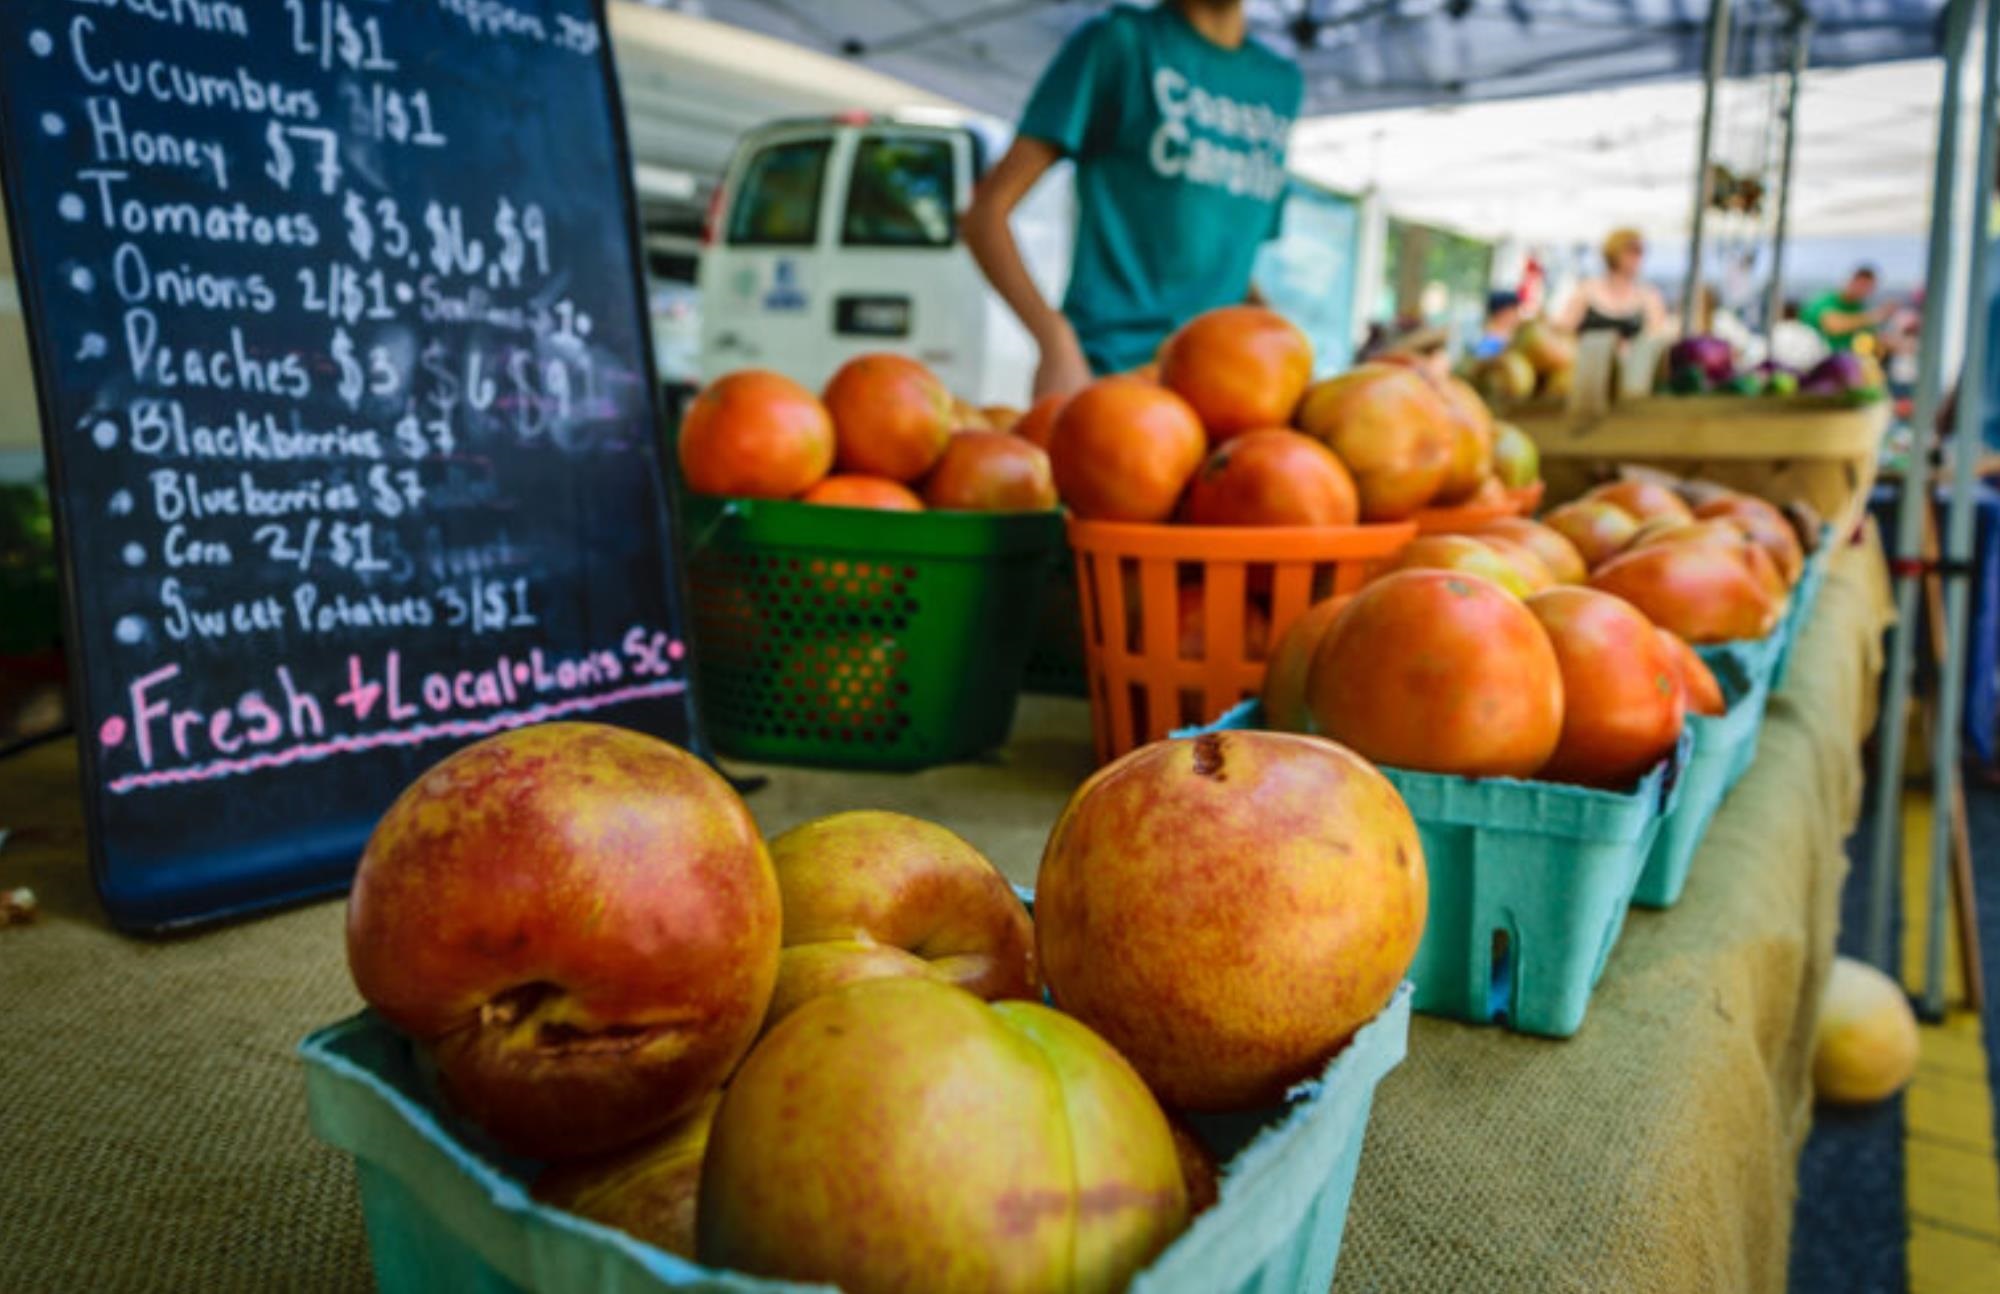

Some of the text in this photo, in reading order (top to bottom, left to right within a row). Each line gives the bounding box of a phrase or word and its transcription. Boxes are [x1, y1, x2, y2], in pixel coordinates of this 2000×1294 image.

[69, 15, 321, 120] Cucumbers
[86, 98, 343, 195] Honey $7
[76, 168, 320, 247] Tomatoes
[113, 242, 276, 313] Onions
[123, 307, 311, 399] Peaches
[330, 325, 400, 412] $3
[129, 398, 454, 460] Blackberries $7
[148, 464, 425, 521] Blueberries $7
[163, 523, 232, 568] Corn
[253, 517, 391, 572] 2/$1
[160, 576, 538, 640] Sweet Potatoes 3/$1
[130, 662, 324, 768] Fresh
[387, 650, 517, 721] Local
